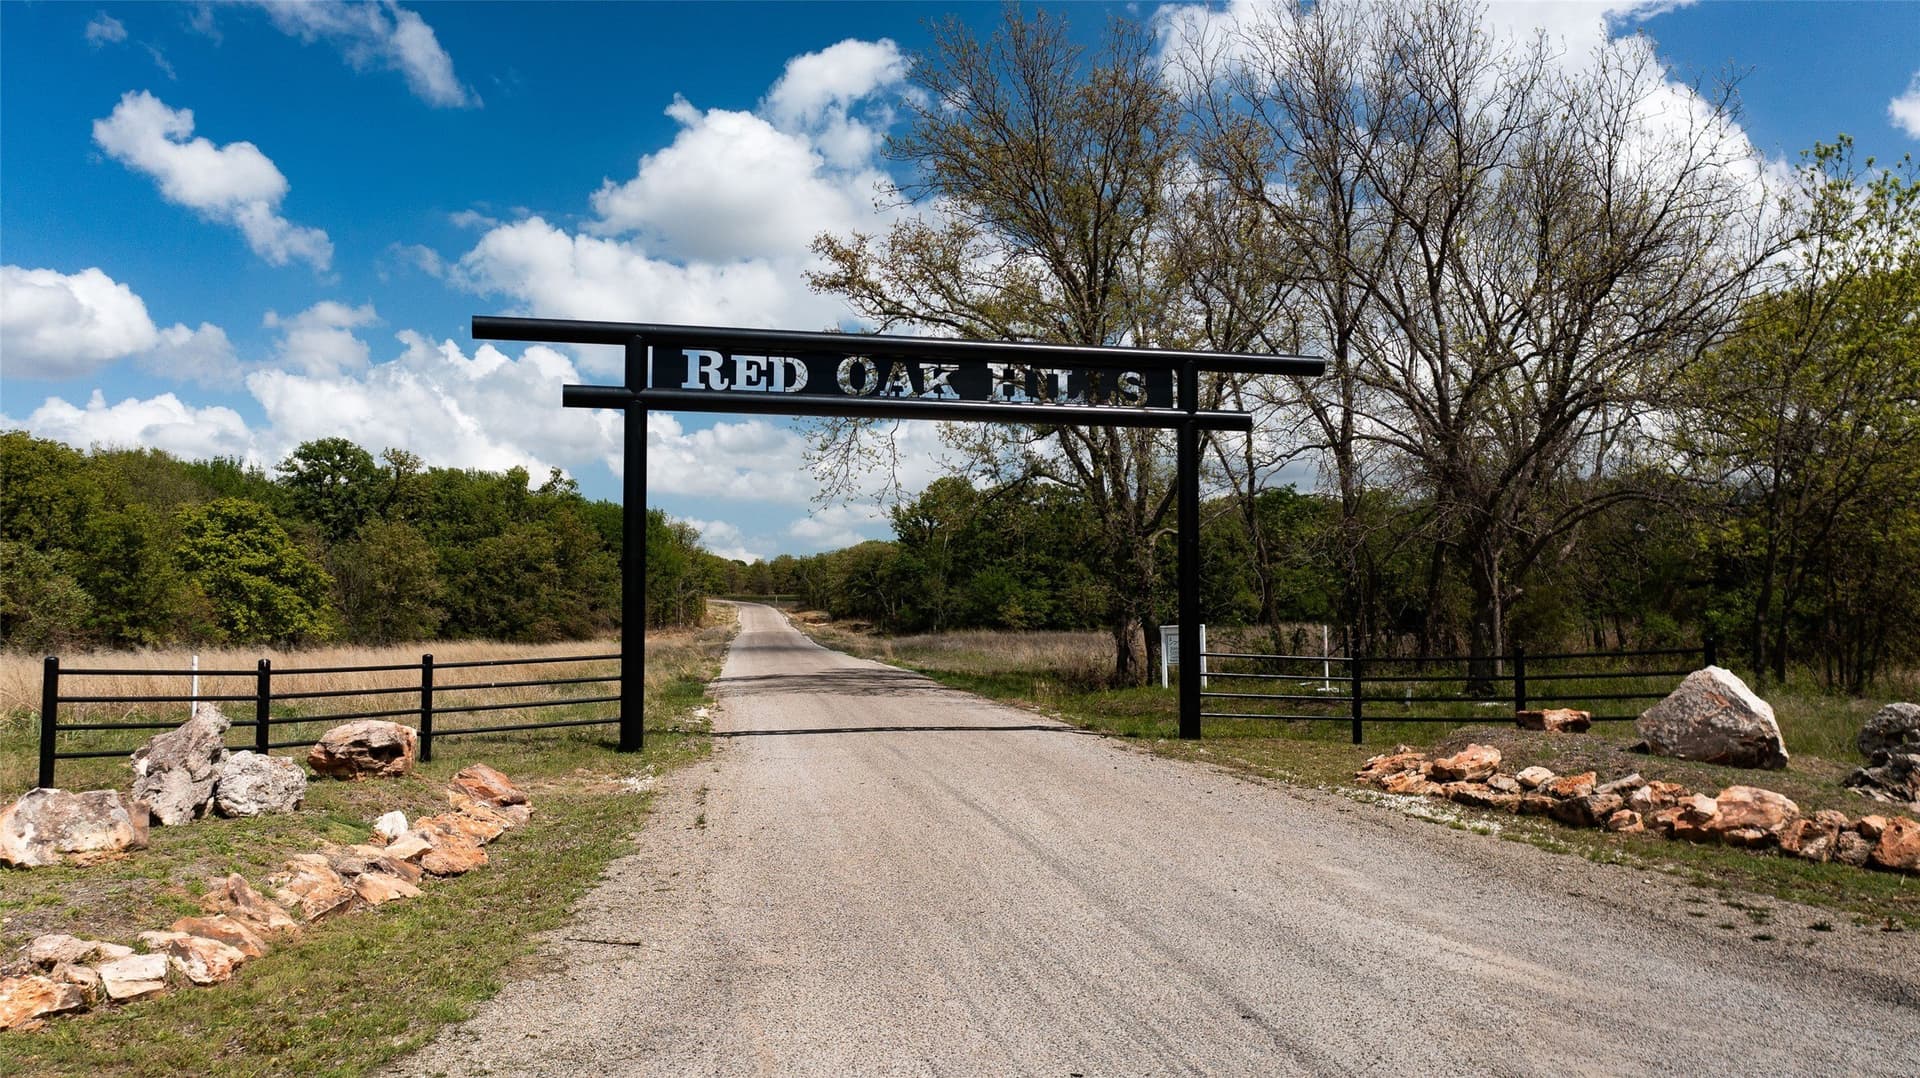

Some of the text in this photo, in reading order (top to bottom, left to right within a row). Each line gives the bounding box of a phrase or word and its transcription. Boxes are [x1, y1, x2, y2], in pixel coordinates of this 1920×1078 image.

[681, 348, 1148, 407] RED OAK HILLS
